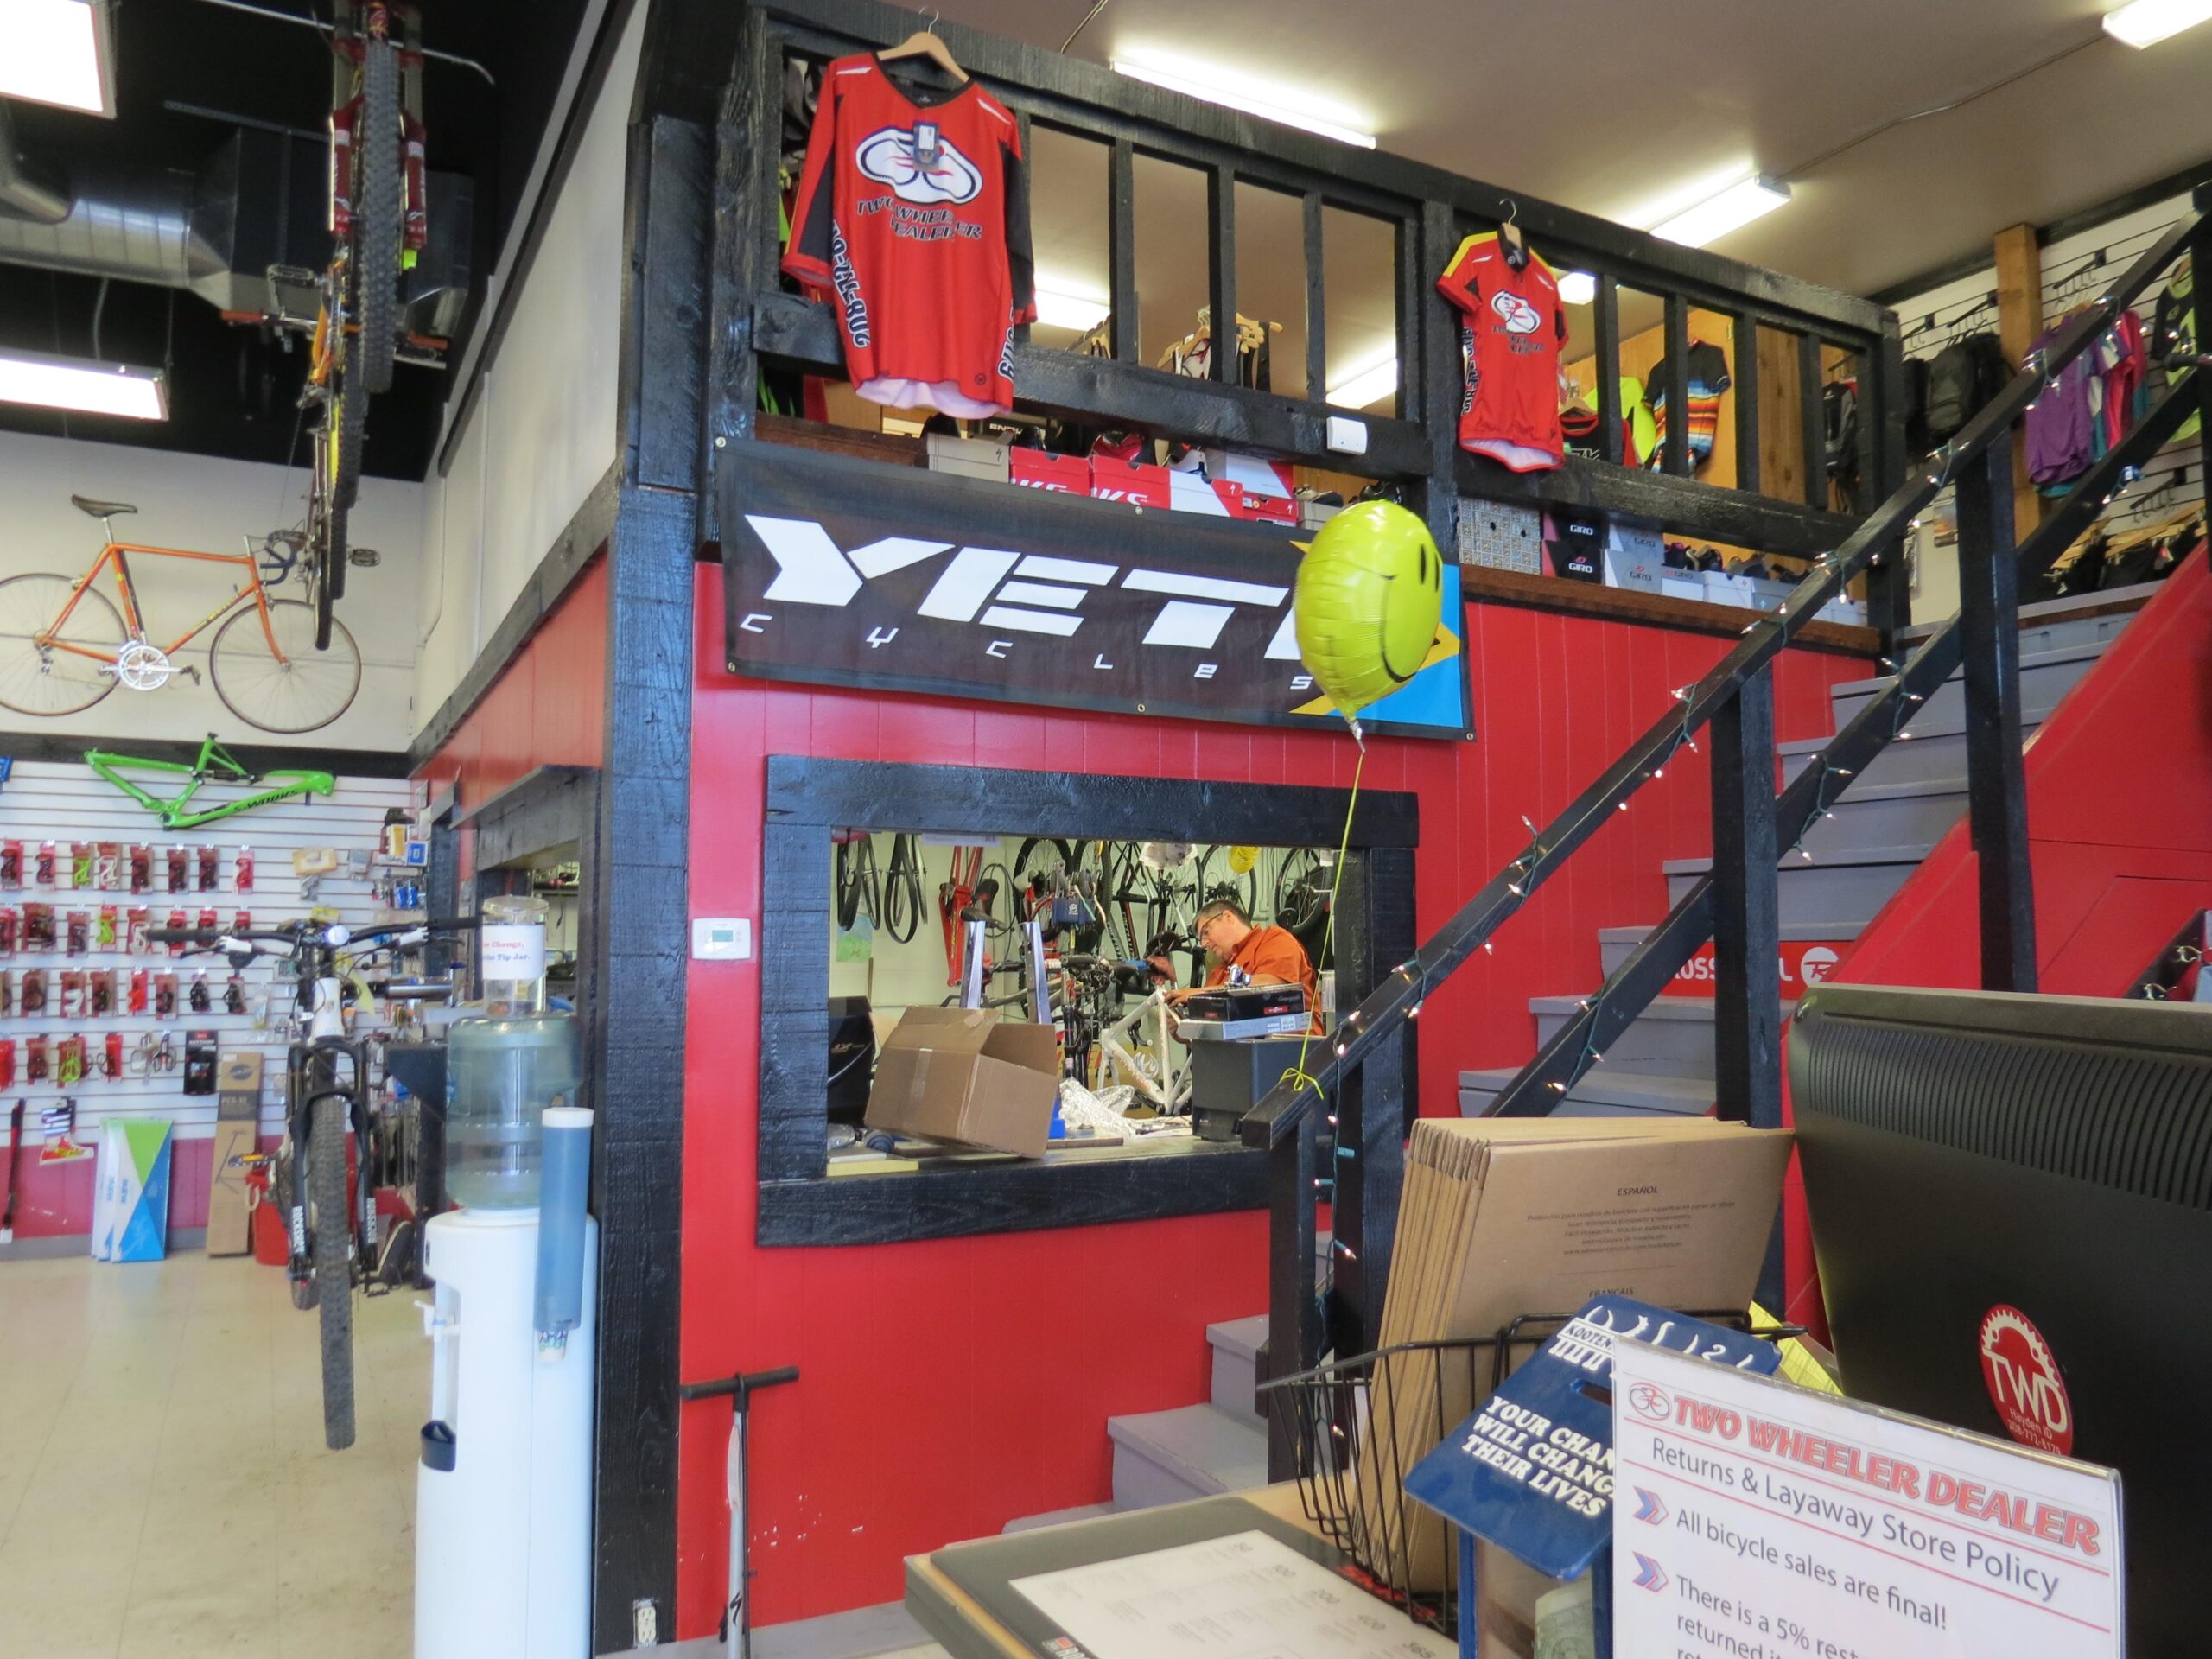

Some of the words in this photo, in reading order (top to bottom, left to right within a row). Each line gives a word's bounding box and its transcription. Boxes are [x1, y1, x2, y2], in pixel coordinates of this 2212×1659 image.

[1569, 524, 1594, 536] GIRO
[1568, 563, 1593, 574] GIRO
[1629, 570, 1652, 582] GIRO
[1565, 1324, 1613, 1350] KOOTEN
[1981, 1347, 2068, 1433] TWD
[2009, 1407, 2041, 1435] Hayden
[2043, 1426, 2053, 1440] ID
[1472, 1414, 1529, 1452] WILL
[1528, 1442, 1614, 1498] CHANG
[1485, 1395, 1552, 1438] YOUR
[1549, 1427, 1614, 1469] CHAN
[1461, 1434, 1533, 1480] THEIR
[1529, 1470, 1607, 1516] LIVES
[1674, 1394, 1741, 1440] TWO
[1746, 1415, 1919, 1499] WHEELER
[1925, 1469, 2100, 1556] DEALER
[1653, 1437, 1734, 1486] Returns
[1741, 1467, 1758, 1495] &
[1765, 1477, 1873, 1538] Layaway
[1882, 1514, 1956, 1562] Store
[1966, 1541, 2060, 1602] Policy
[1676, 1509, 1700, 1535] All
[1707, 1516, 1778, 1565] bicycle
[1784, 1554, 1837, 1587] sales
[1844, 1573, 1879, 1604] are
[1886, 1585, 1947, 1630] final!
[1676, 1573, 1732, 1617] There
[1738, 1600, 1752, 1625] is
[1758, 1614, 1769, 1633] a
[1777, 1617, 1809, 1650] 5%
[1677, 1614, 1763, 1659] returned
